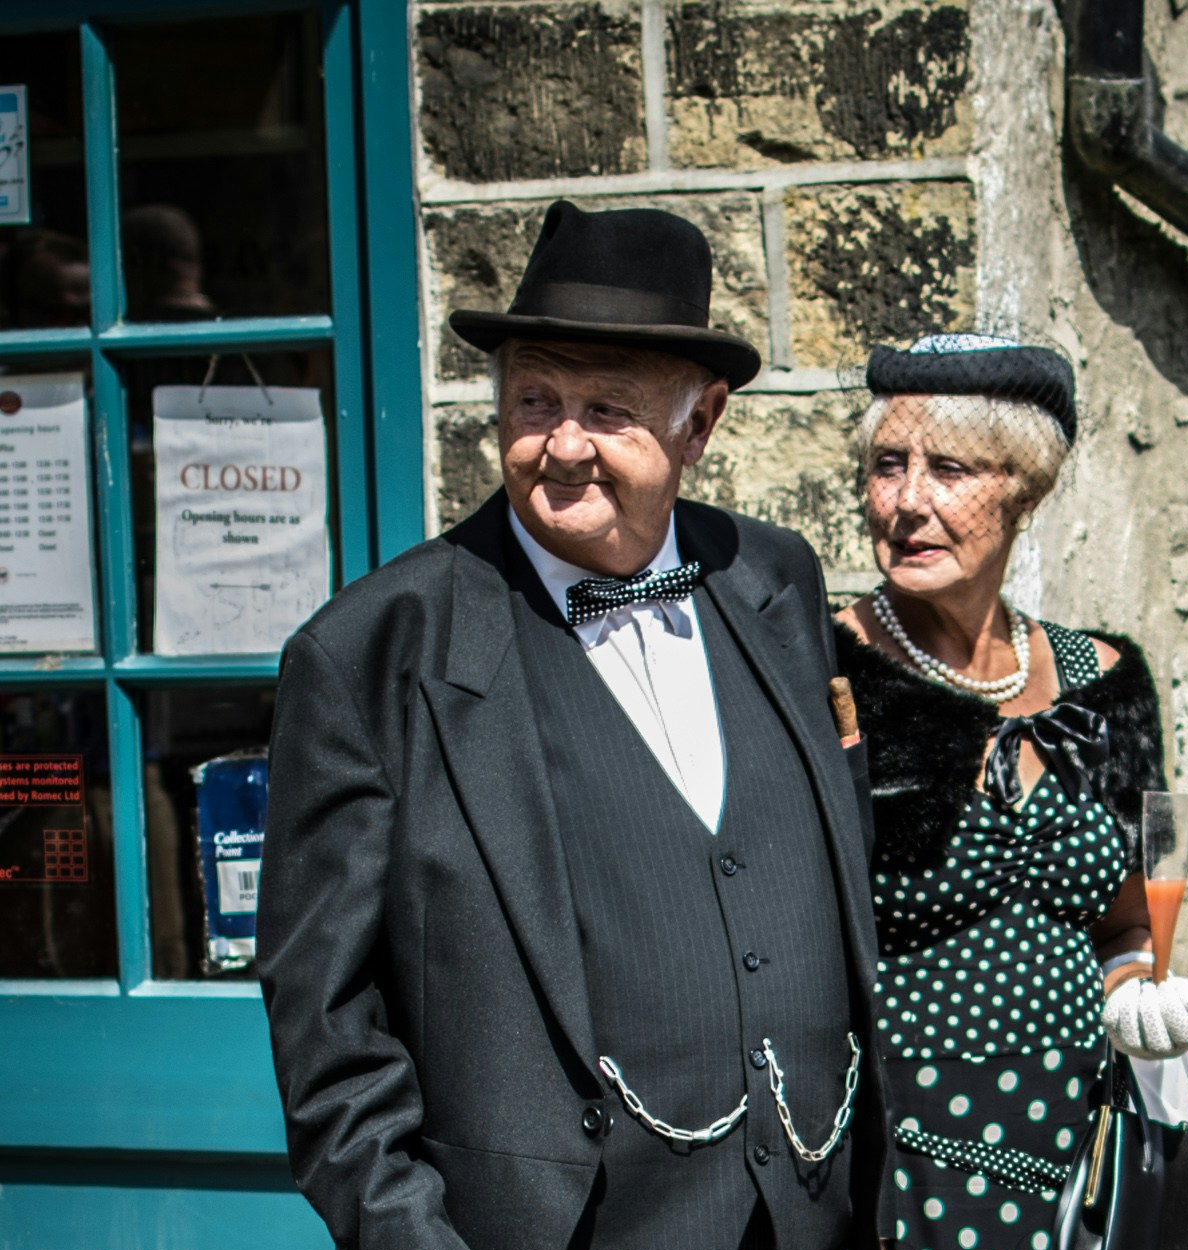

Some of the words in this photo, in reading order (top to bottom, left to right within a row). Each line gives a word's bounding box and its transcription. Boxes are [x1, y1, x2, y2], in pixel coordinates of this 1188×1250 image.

[180, 463, 302, 492] CLOSED
[181, 508, 231, 527] Opening
[233, 510, 267, 524] hours
[269, 514, 287, 524] are
[289, 514, 301, 525] as
[222, 531, 259, 545] shown
[15, 762, 31, 771] are
[33, 760, 79, 773] protected
[31, 775, 79, 786] monitored
[17, 789, 29, 803] by
[31, 790, 62, 801] Romec
[64, 790, 80, 801] Ltd
